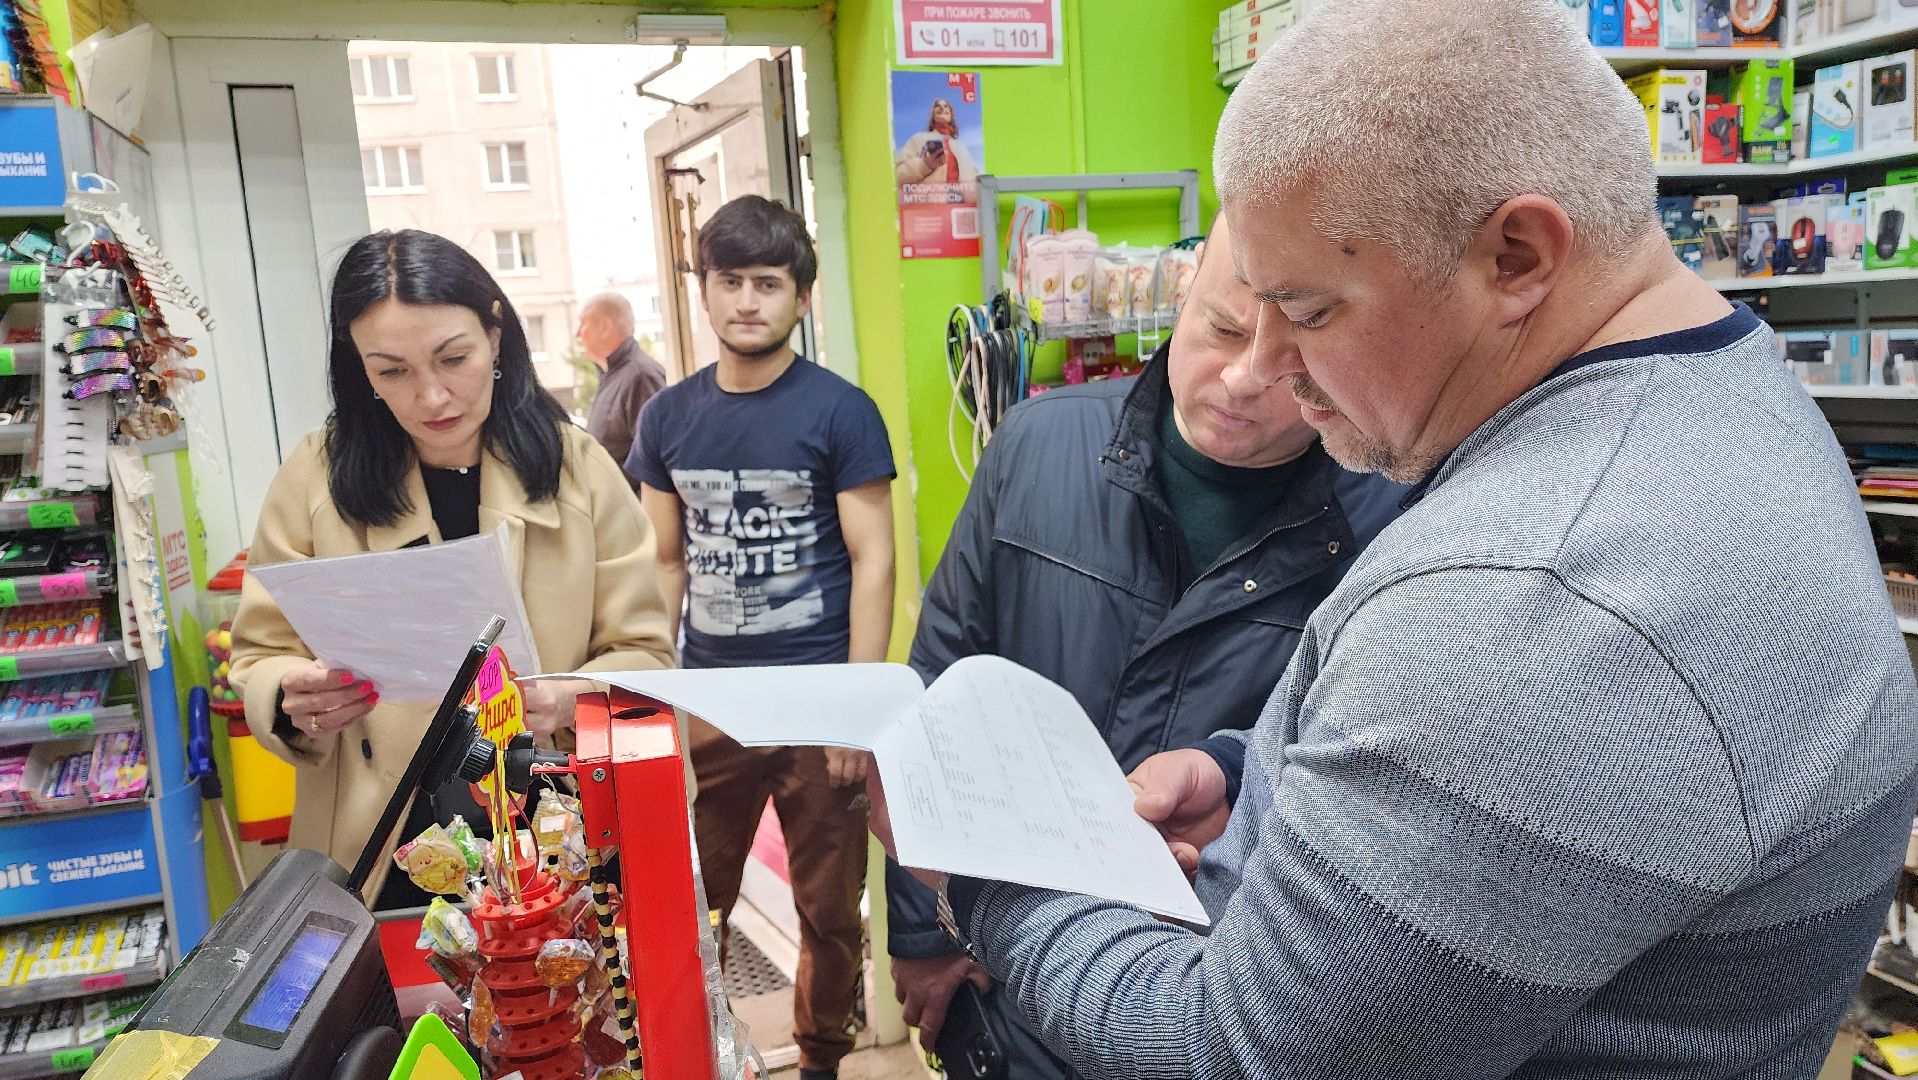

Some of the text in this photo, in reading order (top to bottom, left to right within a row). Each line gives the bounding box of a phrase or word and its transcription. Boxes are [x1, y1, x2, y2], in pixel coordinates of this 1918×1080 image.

[923, 6, 1031, 19] ПРИ ПОЖАРЕ ЗВОНИТЬ
[941, 28, 1038, 48] 01 или 101
[34, 151, 46, 164] И
[904, 193, 962, 204] МТС ЗДЕСЬ
[163, 530, 186, 556] МТС
[735, 585, 761, 597] YORK
[48, 848, 144, 871] ЧИСТЫЕ ЗУБЫ И
[49, 859, 145, 884] СВЕЖЕЕ ДЫХАНИЕ
